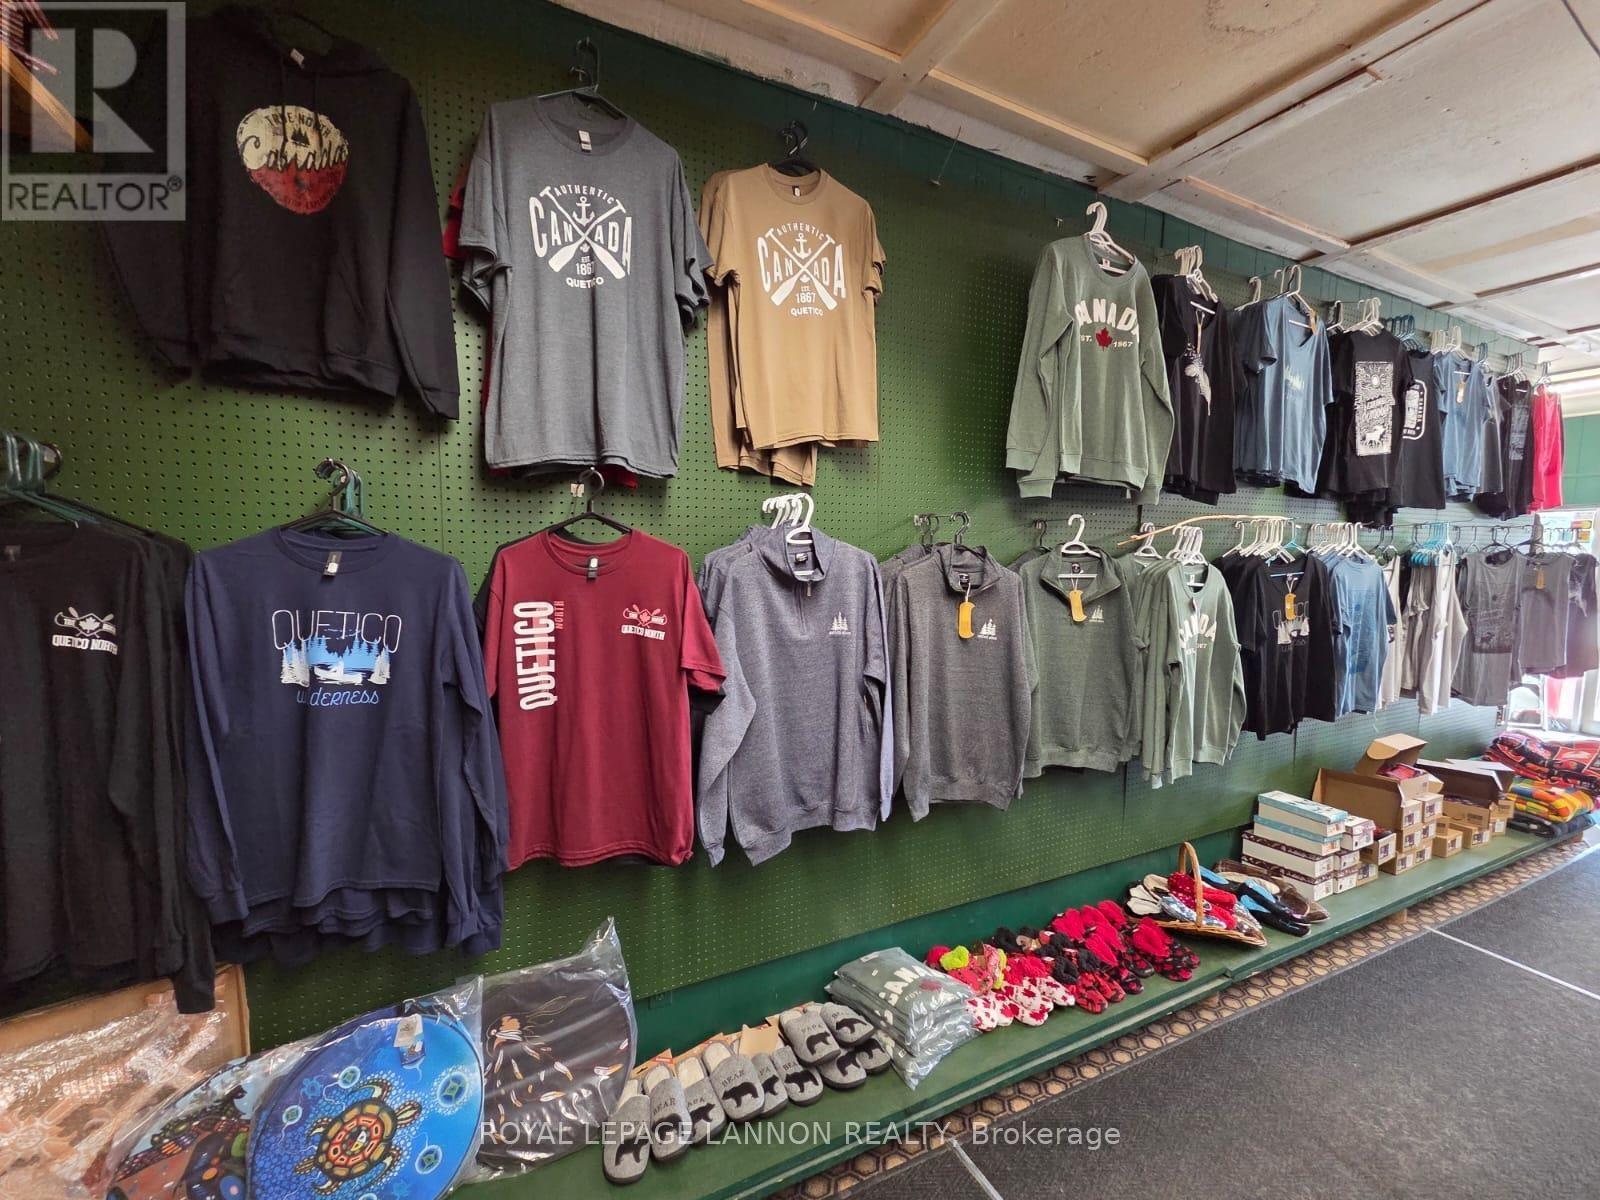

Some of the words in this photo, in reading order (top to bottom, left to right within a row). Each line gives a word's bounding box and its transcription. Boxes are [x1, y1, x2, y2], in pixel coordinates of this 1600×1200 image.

[554, 184, 615, 204] AUTHENTIC
[529, 196, 632, 276] CANADA
[776, 222, 825, 241] AUTHENTIC
[757, 236, 846, 299] CANADA
[566, 276, 604, 288] QUETO
[796, 292, 816, 304] 1867
[790, 306, 824, 317] QUETICO
[553, 600, 565, 630] NORTH
[271, 609, 402, 653] QUETICO
[513, 602, 557, 710] QUETICO
